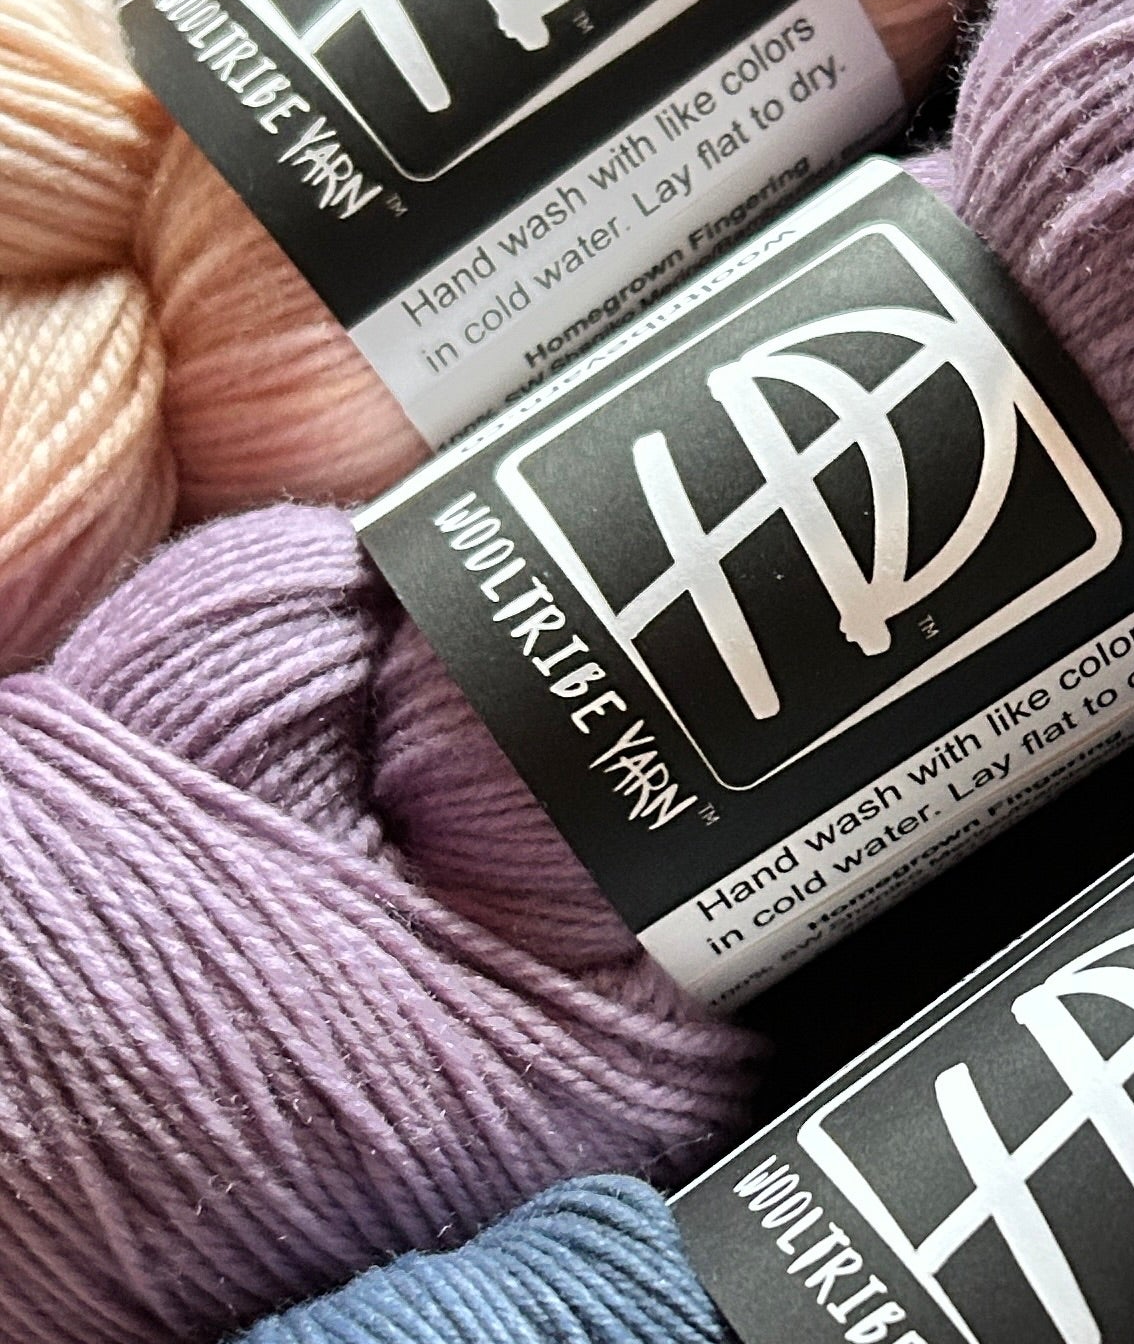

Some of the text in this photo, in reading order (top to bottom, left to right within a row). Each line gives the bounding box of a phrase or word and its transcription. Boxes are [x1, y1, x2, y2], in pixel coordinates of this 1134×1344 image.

[277, 115, 384, 220] YARN
[400, 17, 815, 327] Hand wash with like colors
[421, 55, 846, 373] in cold water. Lay flat to dry.
[523, 156, 810, 369] Homegrown Fingering
[434, 491, 627, 734] WOOLTRIBE
[589, 719, 698, 830] YARN
[696, 845, 800, 922] Hand
[803, 785, 903, 852] wash
[906, 733, 982, 786] with
[985, 688, 1051, 737] like
[706, 929, 745, 956] in
[752, 869, 828, 928] cold
[832, 804, 941, 874] water.
[947, 753, 1011, 802] Lay
[1020, 711, 1078, 755] flat
[1082, 688, 1118, 716] to
